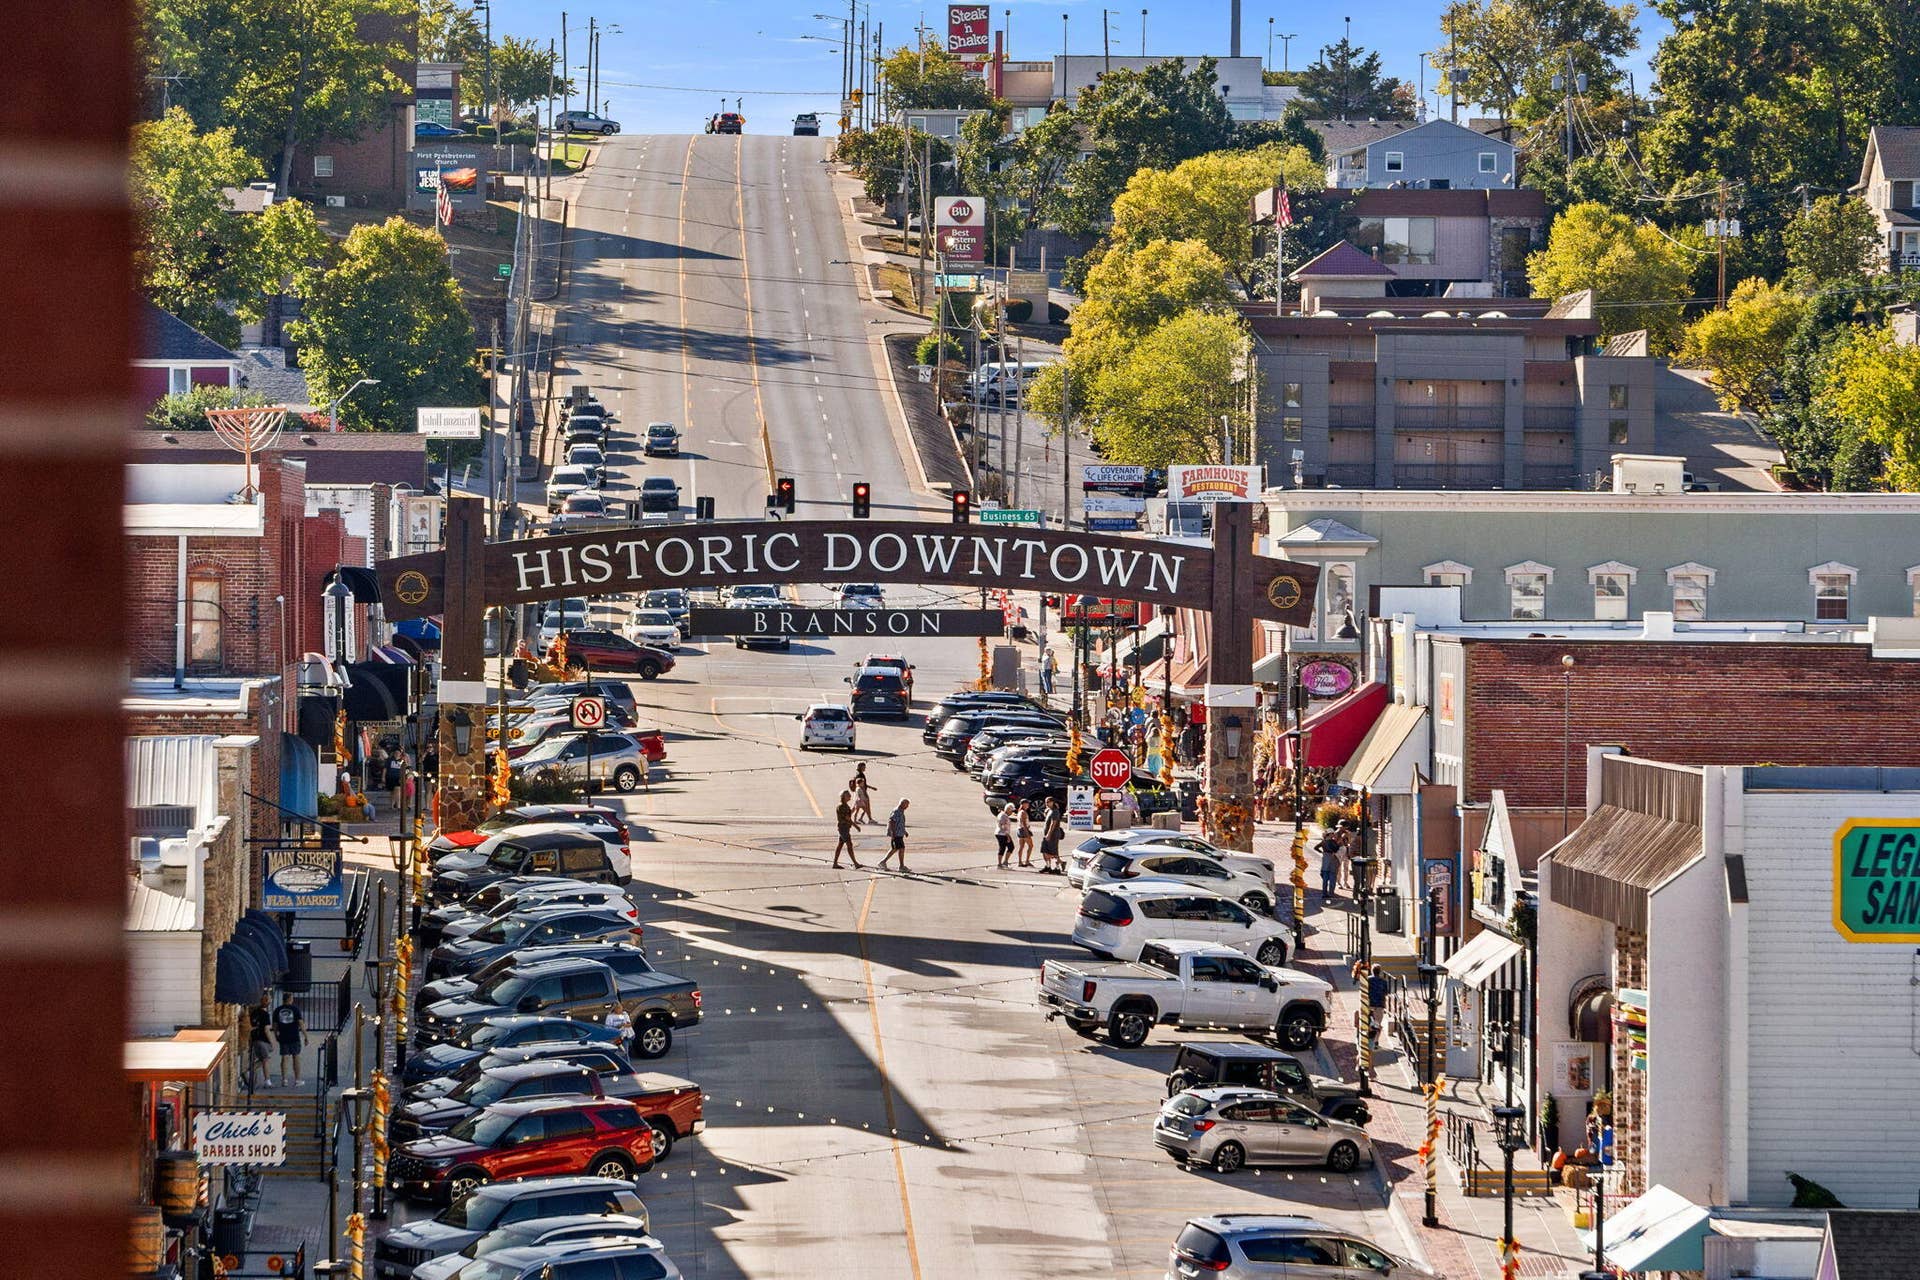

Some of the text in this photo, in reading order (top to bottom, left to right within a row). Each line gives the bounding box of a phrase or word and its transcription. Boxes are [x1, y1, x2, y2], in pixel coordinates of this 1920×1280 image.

[951, 8, 987, 24] Steak
[949, 34, 988, 50] Shake
[951, 206, 970, 216] BW
[944, 236, 976, 244] Wstern
[1182, 468, 1248, 486] FARMHOUSE
[1191, 481, 1238, 492] RESTAURANT
[983, 512, 1036, 521] Business 65
[512, 532, 1185, 594] HISTORIC DOWNTOWN
[754, 611, 942, 635] BRANSON
[1093, 761, 1129, 777] STOP
[267, 851, 337, 880] MAIN STREET
[265, 895, 339, 906] FLEA MARKET
[205, 1119, 274, 1141] Chick's
[202, 1145, 277, 1158] BARBER SHOP
